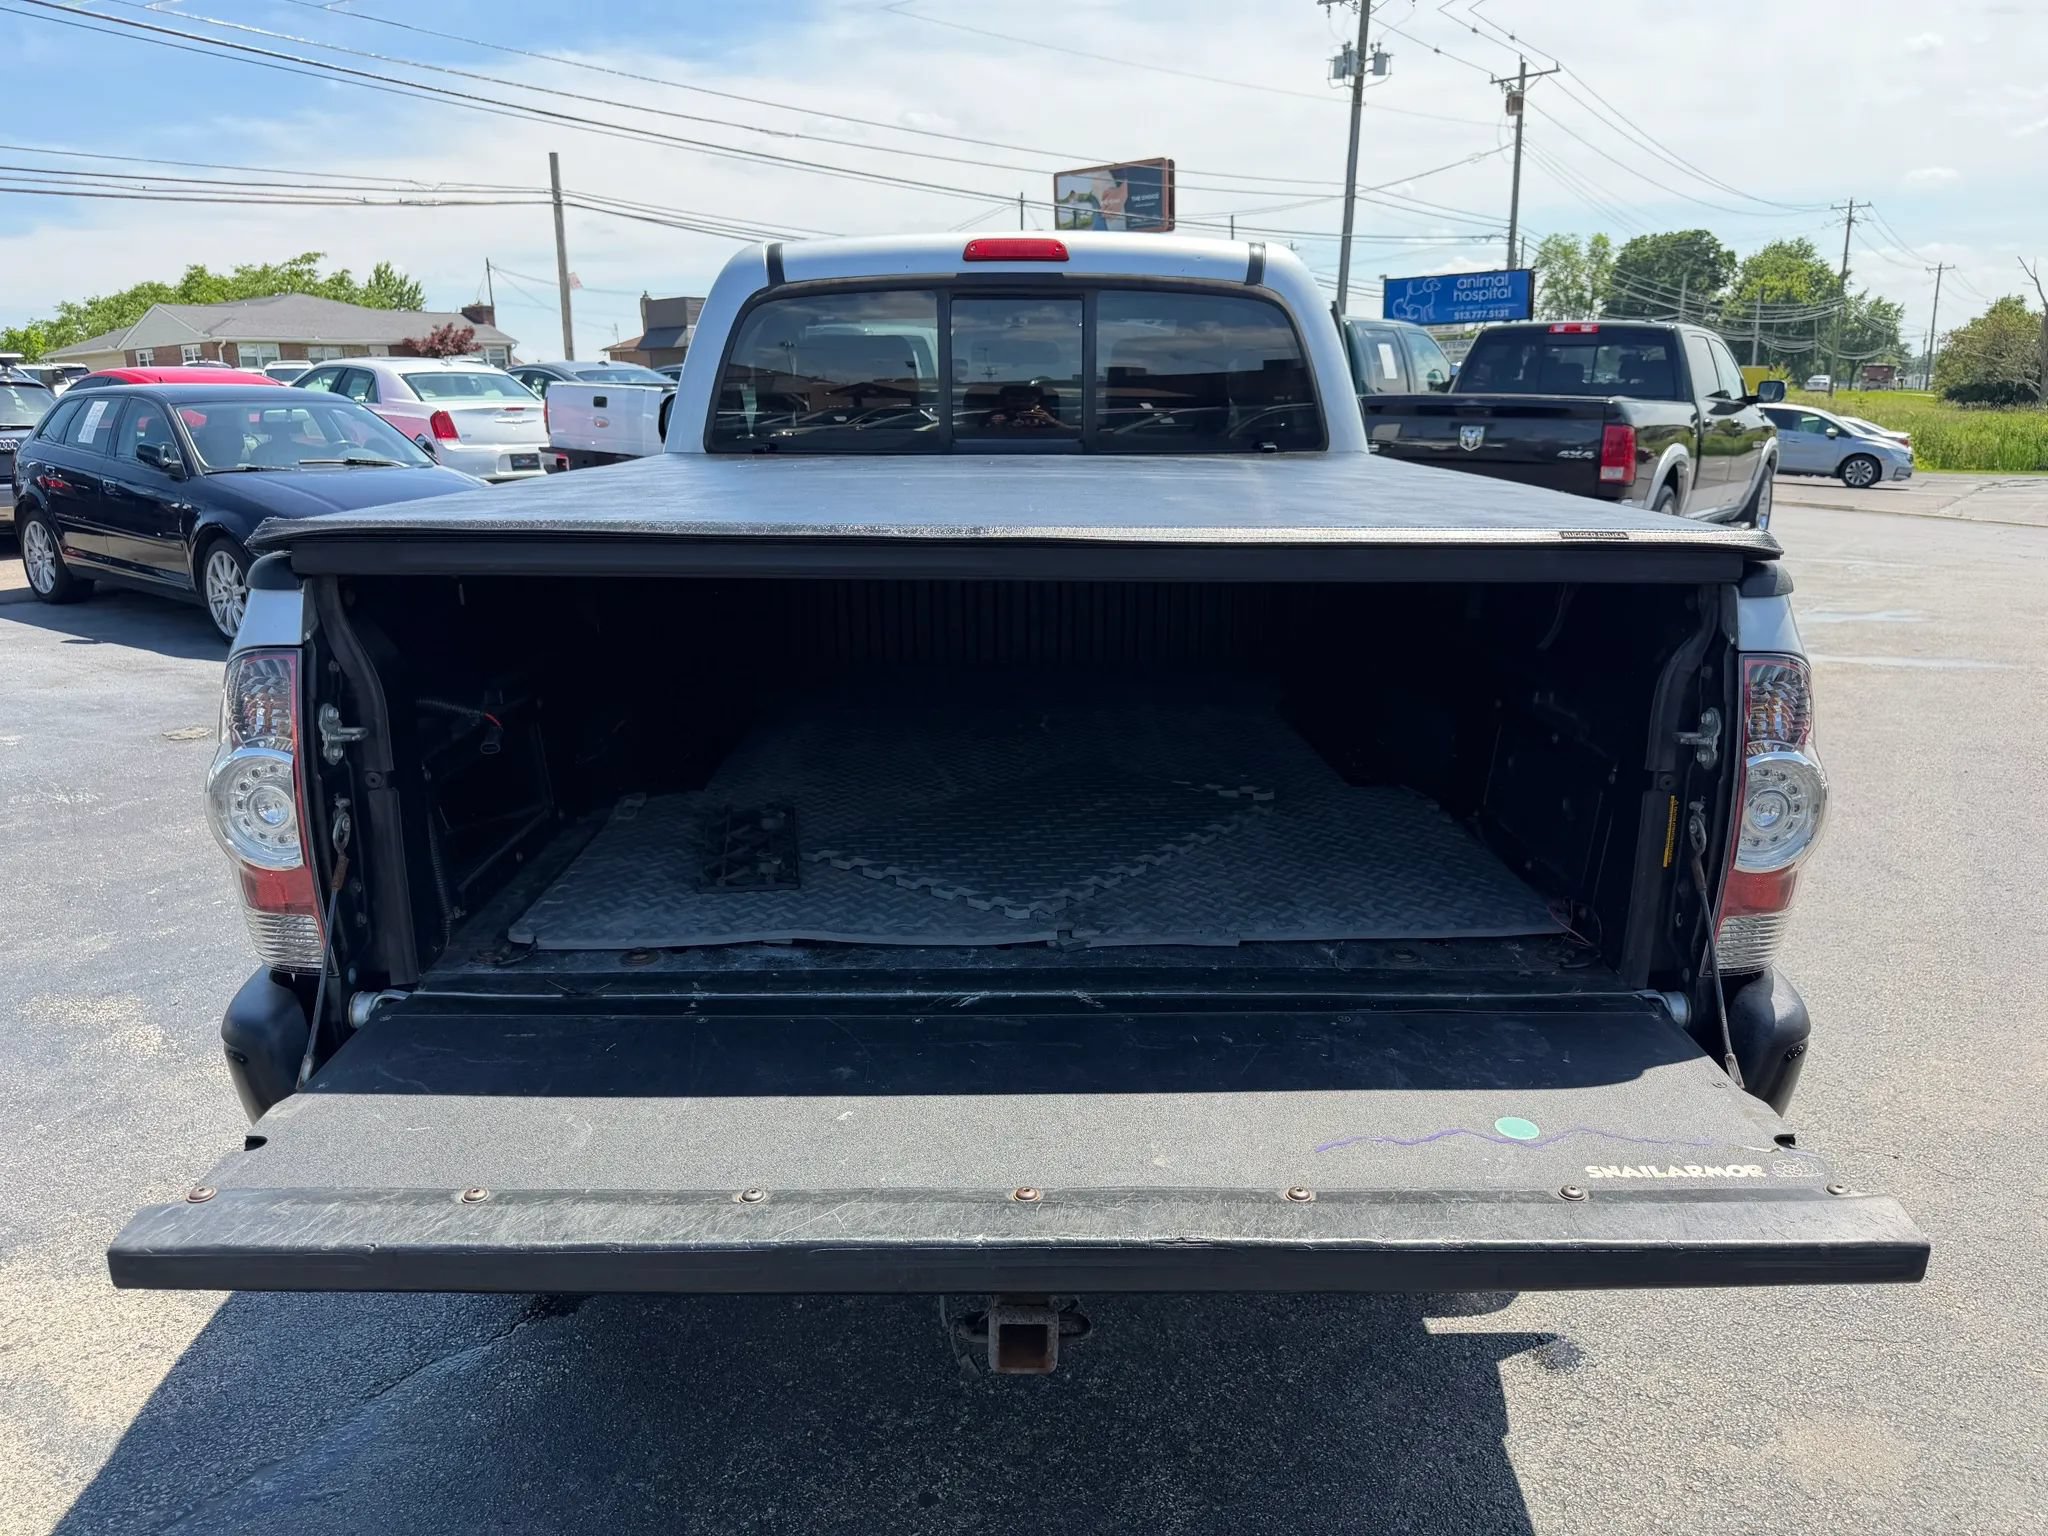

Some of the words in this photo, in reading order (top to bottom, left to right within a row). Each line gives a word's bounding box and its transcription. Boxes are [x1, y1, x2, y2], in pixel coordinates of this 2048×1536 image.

[1457, 273, 1509, 289] animal
[1453, 285, 1512, 302] hospital
[1584, 1164, 1766, 1178] SNAILARMOR
